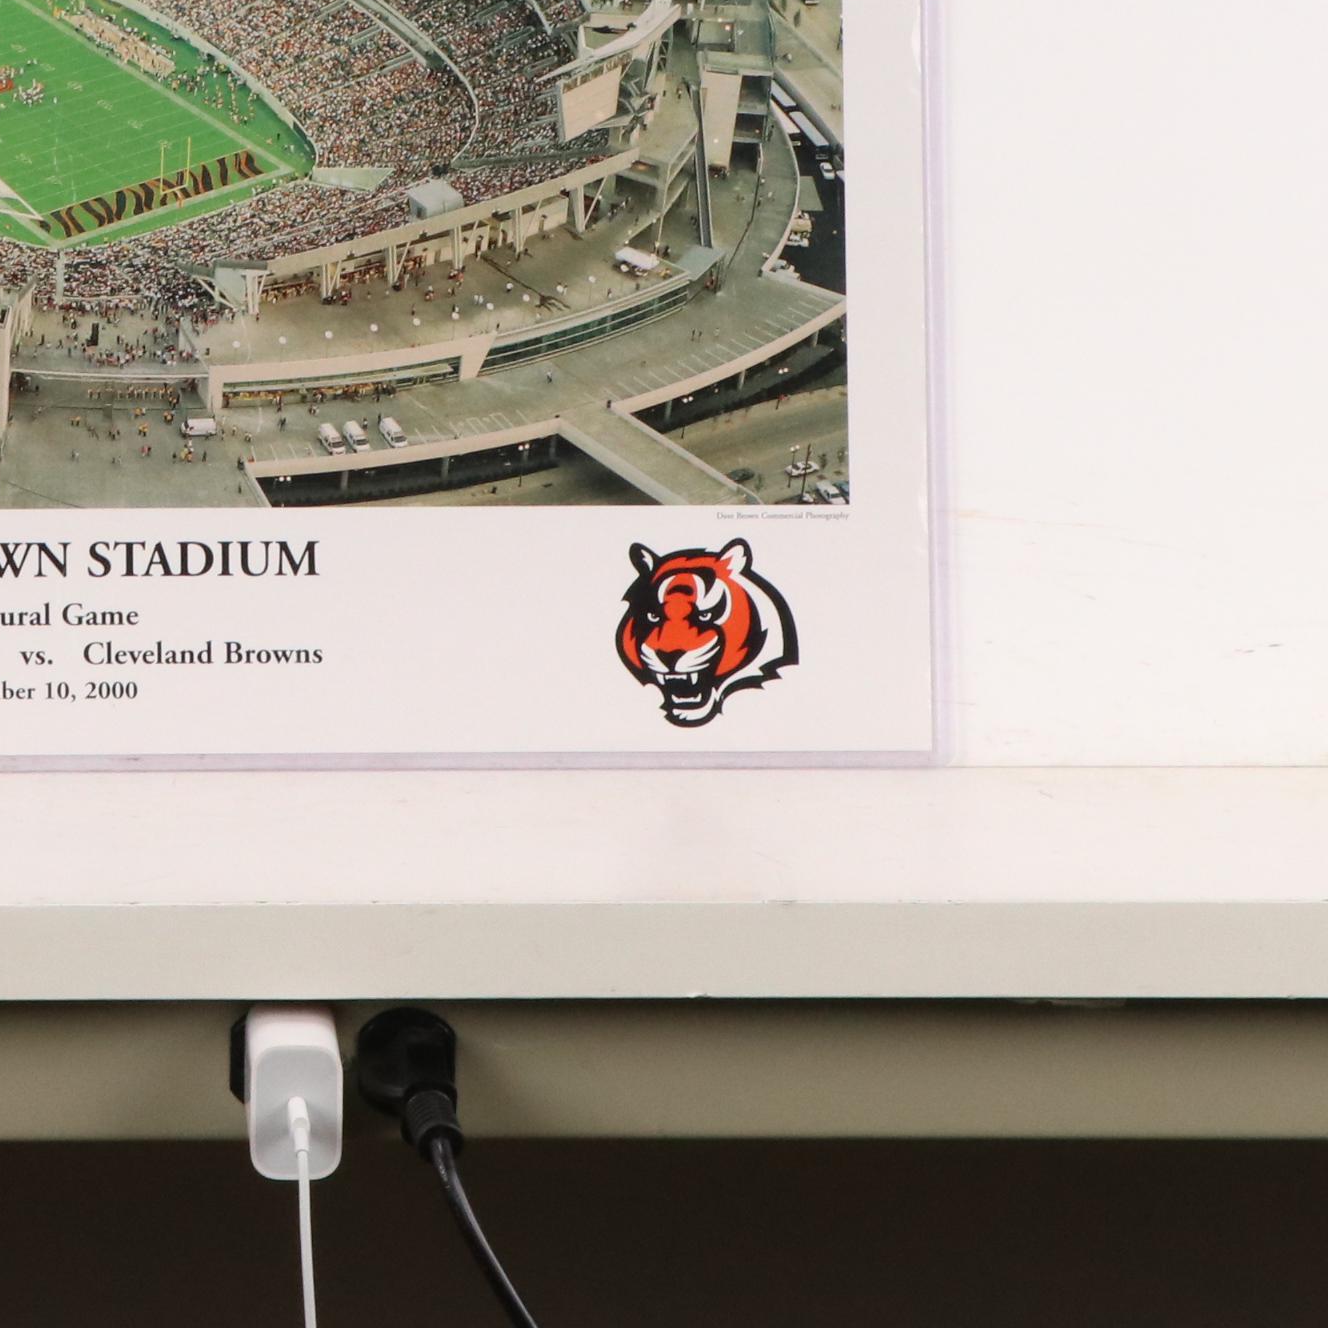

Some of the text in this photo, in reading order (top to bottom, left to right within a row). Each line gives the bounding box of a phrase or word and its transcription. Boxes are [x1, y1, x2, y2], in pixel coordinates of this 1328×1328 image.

[760, 511, 803, 520] Commercial
[805, 511, 850, 522] Photography
[87, 540, 320, 578] STADIUM
[61, 603, 139, 627] Game
[19, 650, 54, 666] vs.
[83, 640, 214, 665] Cleveland
[224, 641, 323, 665] Browns
[45, 682, 76, 701] 10,
[85, 681, 138, 700] 2000
